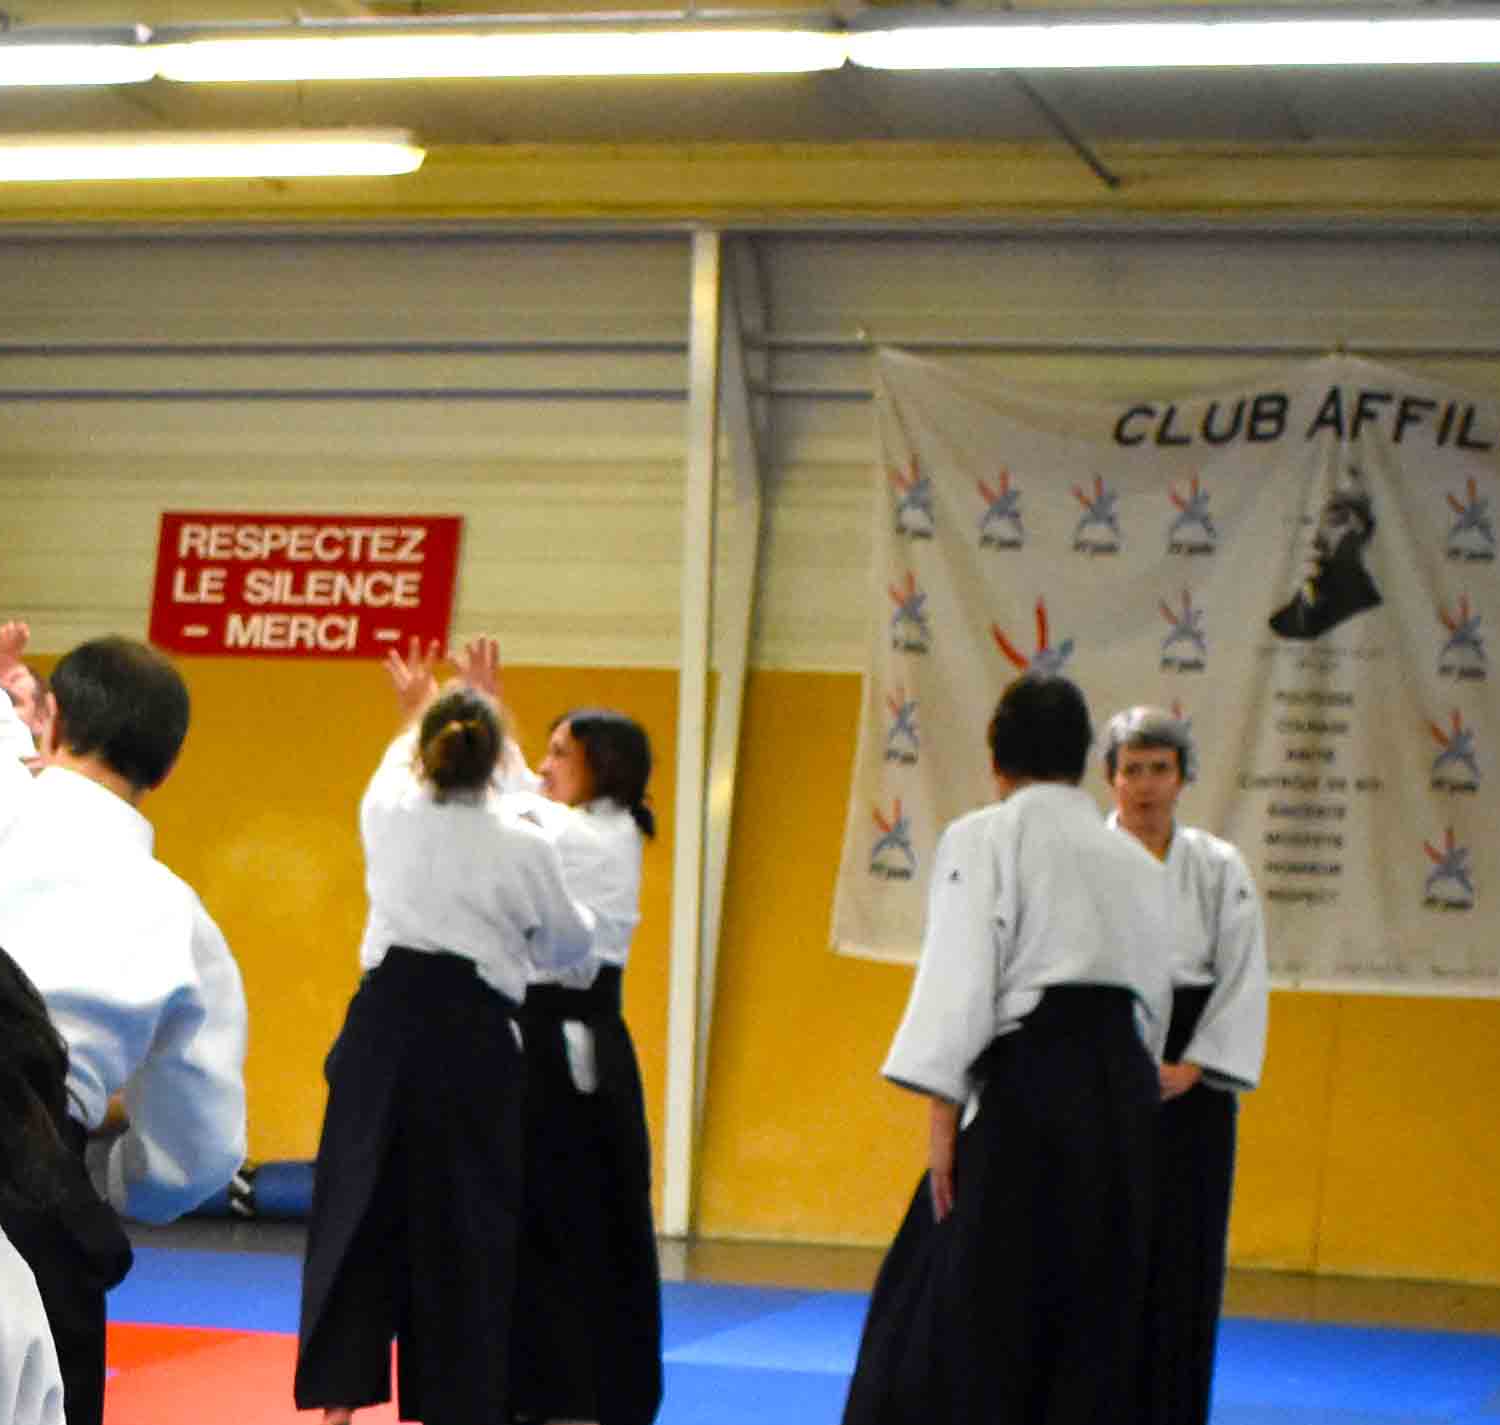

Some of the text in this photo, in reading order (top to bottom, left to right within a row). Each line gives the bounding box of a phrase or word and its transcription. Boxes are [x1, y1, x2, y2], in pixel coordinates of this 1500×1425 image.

[1112, 392, 1288, 447] CLUB
[178, 523, 428, 564] RESPECTEZ
[172, 568, 423, 608] LE SILENCE
[224, 613, 360, 650] MERCI
